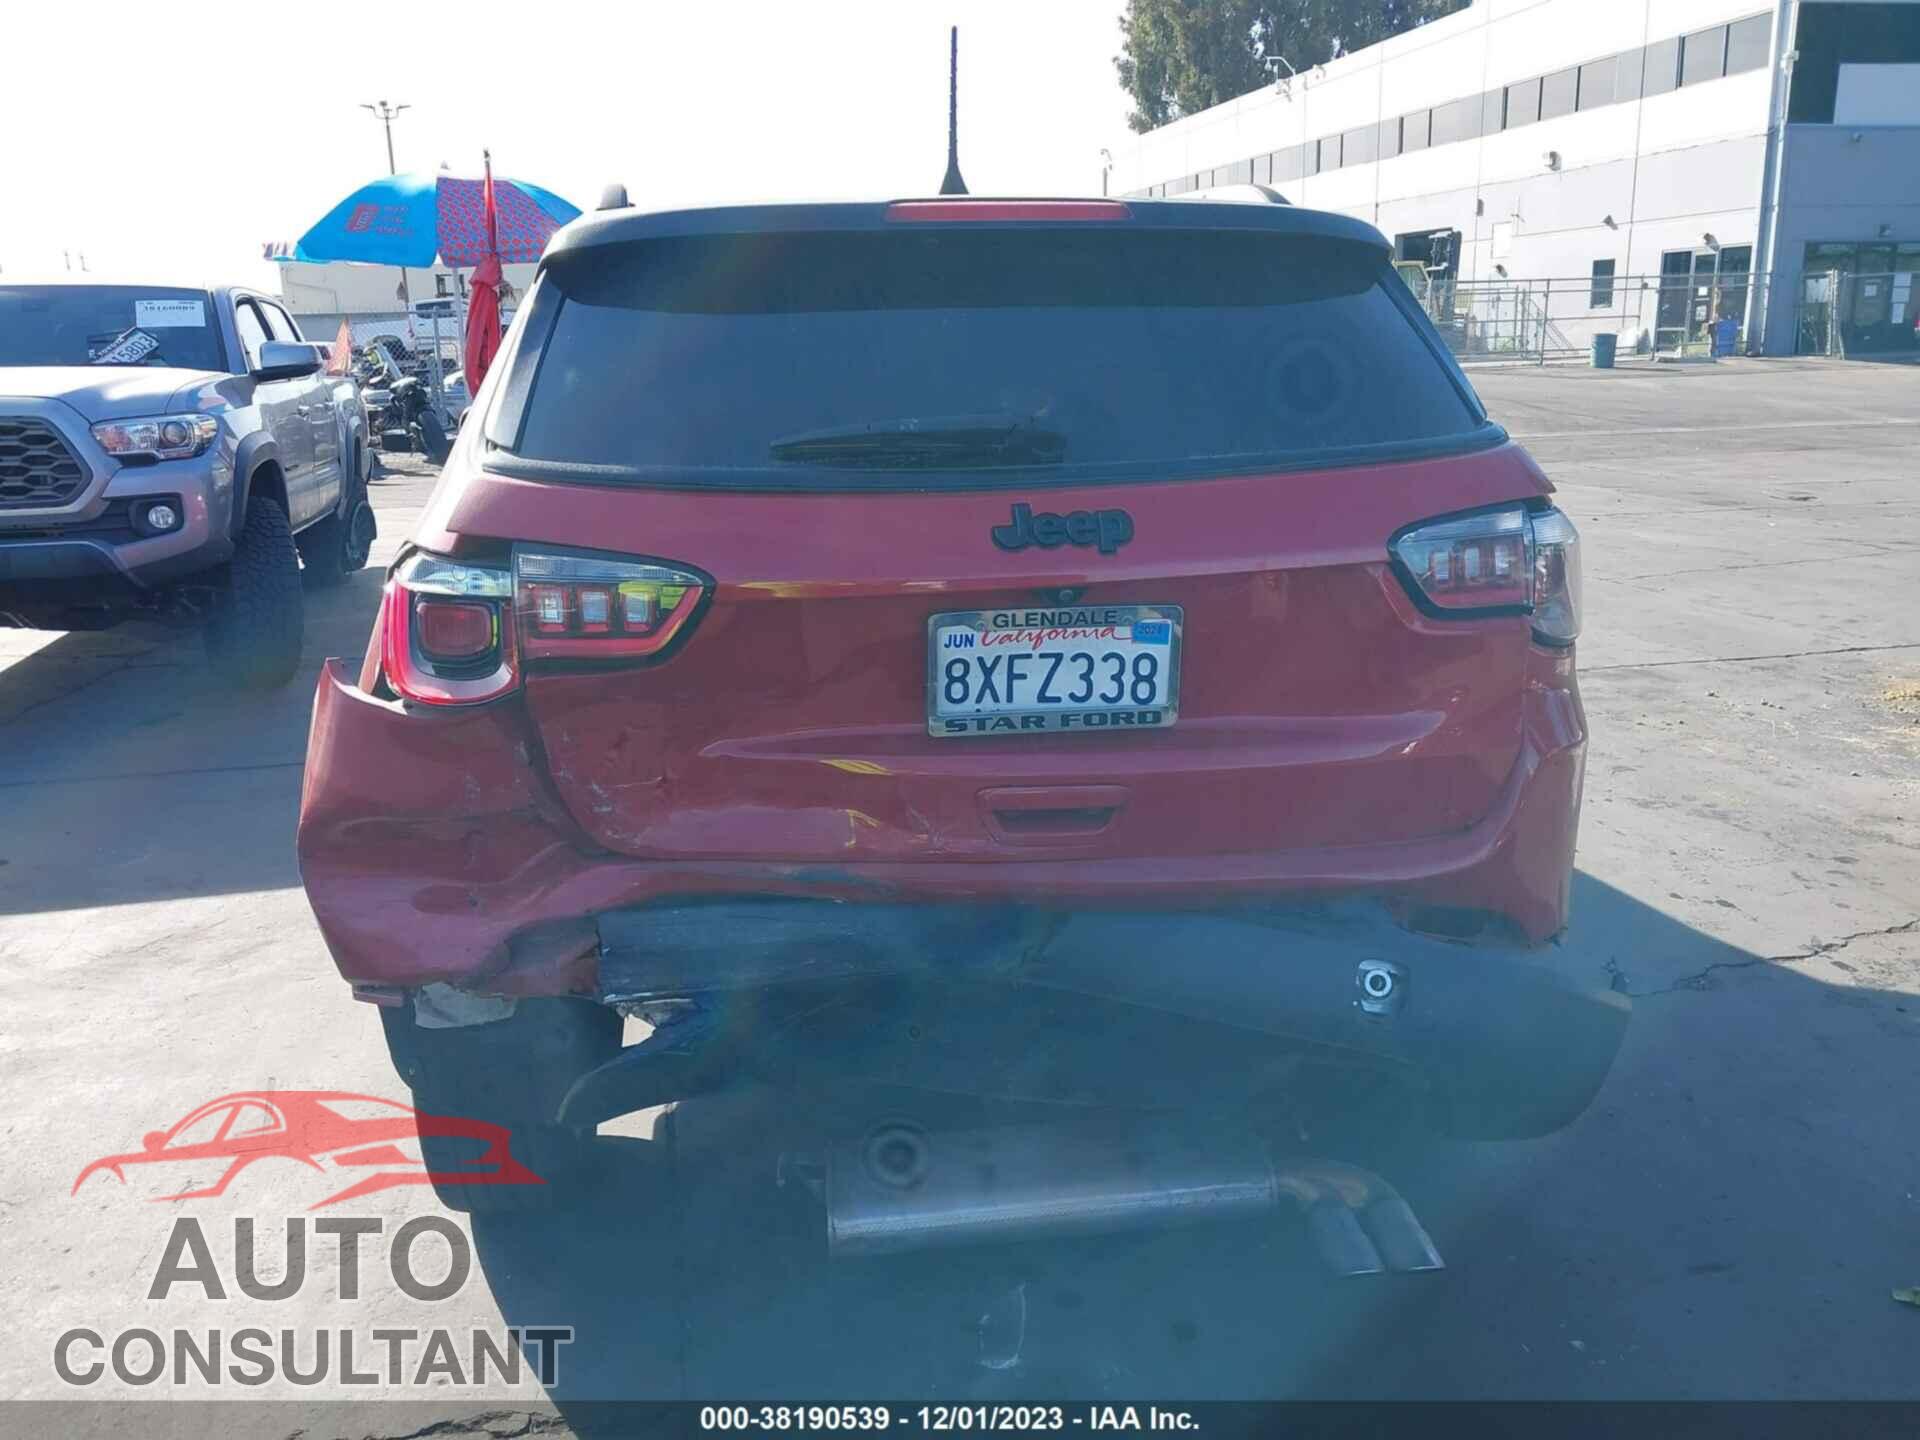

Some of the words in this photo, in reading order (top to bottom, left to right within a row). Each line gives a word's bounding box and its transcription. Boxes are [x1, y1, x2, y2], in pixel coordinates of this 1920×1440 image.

[991, 502, 1135, 555] Jeep
[992, 609, 1118, 629] GLENDALE
[944, 633, 975, 649] JUN
[980, 625, 1133, 651] California
[944, 651, 1159, 706] 8XFZ338
[944, 714, 1046, 733] STAR
[1060, 710, 1163, 728] FORD
